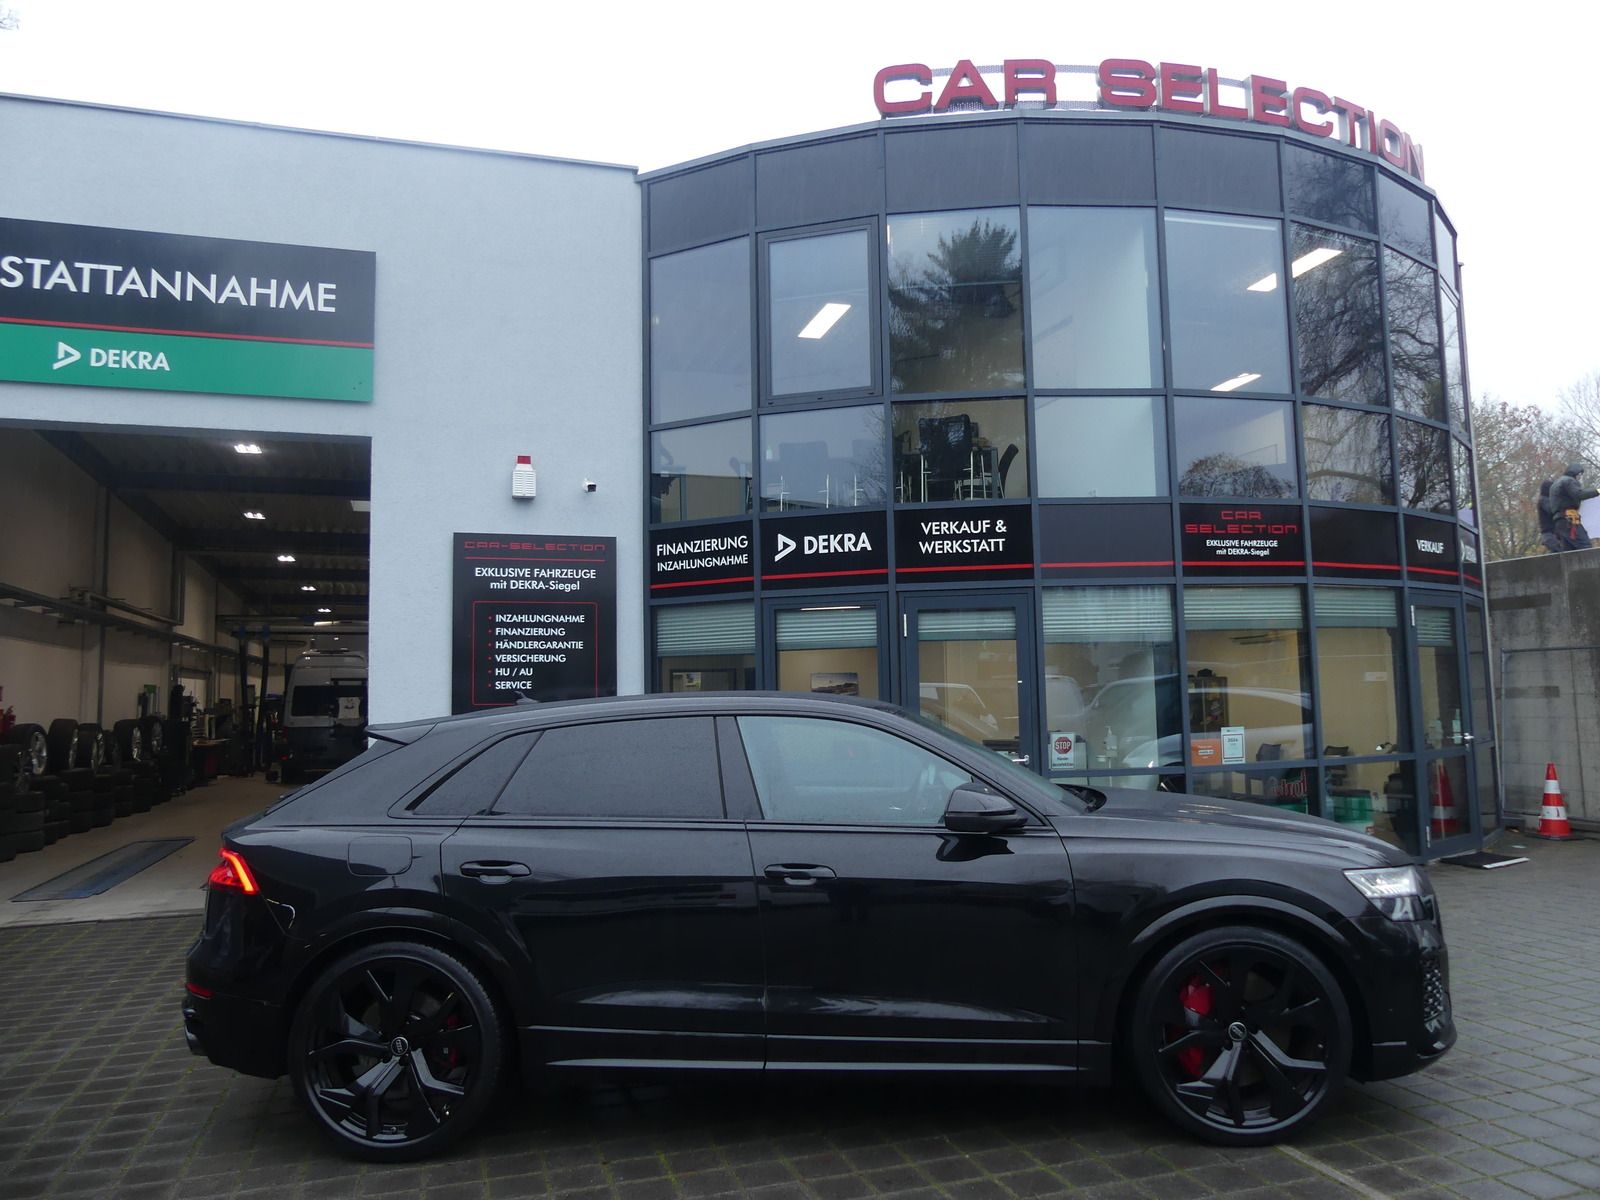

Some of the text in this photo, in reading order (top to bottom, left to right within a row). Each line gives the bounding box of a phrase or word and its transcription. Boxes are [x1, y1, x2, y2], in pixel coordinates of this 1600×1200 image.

[873, 58, 1425, 185] CAR SELECTION
[0, 255, 337, 313] STATTANNAHME
[90, 348, 171, 372] DEKRA
[1221, 511, 1261, 520] CAR
[921, 519, 1007, 536] VERKAUF &
[1185, 525, 1297, 534] SELECTION
[464, 541, 606, 551] CAR-SELECTION
[656, 535, 749, 557] FINANZIERUNG
[804, 532, 872, 555] DEKRA
[919, 538, 1006, 554] WERKSTATT
[1206, 539, 1278, 548] EXKLUSIVE FAHRZEUGE
[1416, 539, 1444, 553] VERKAUF
[1216, 547, 1270, 557] mit DEKRA-Siegel
[657, 553, 749, 572] INZAHLUNGNAHME
[475, 567, 597, 579] EXKLUSIVE FAHRZEUGE
[490, 580, 580, 592] mit DEKRA-Siegel
[496, 614, 585, 623] INZAHLUNGNAHME
[496, 628, 566, 636] FINANZIERUNG
[496, 640, 584, 649] HÄNDLERGARANTIE
[496, 654, 566, 663] VERSICHERUNG
[496, 668, 510, 676] HU
[519, 668, 533, 676] AU
[495, 681, 532, 690] SERVICE
[1056, 742, 1071, 750] STOP
